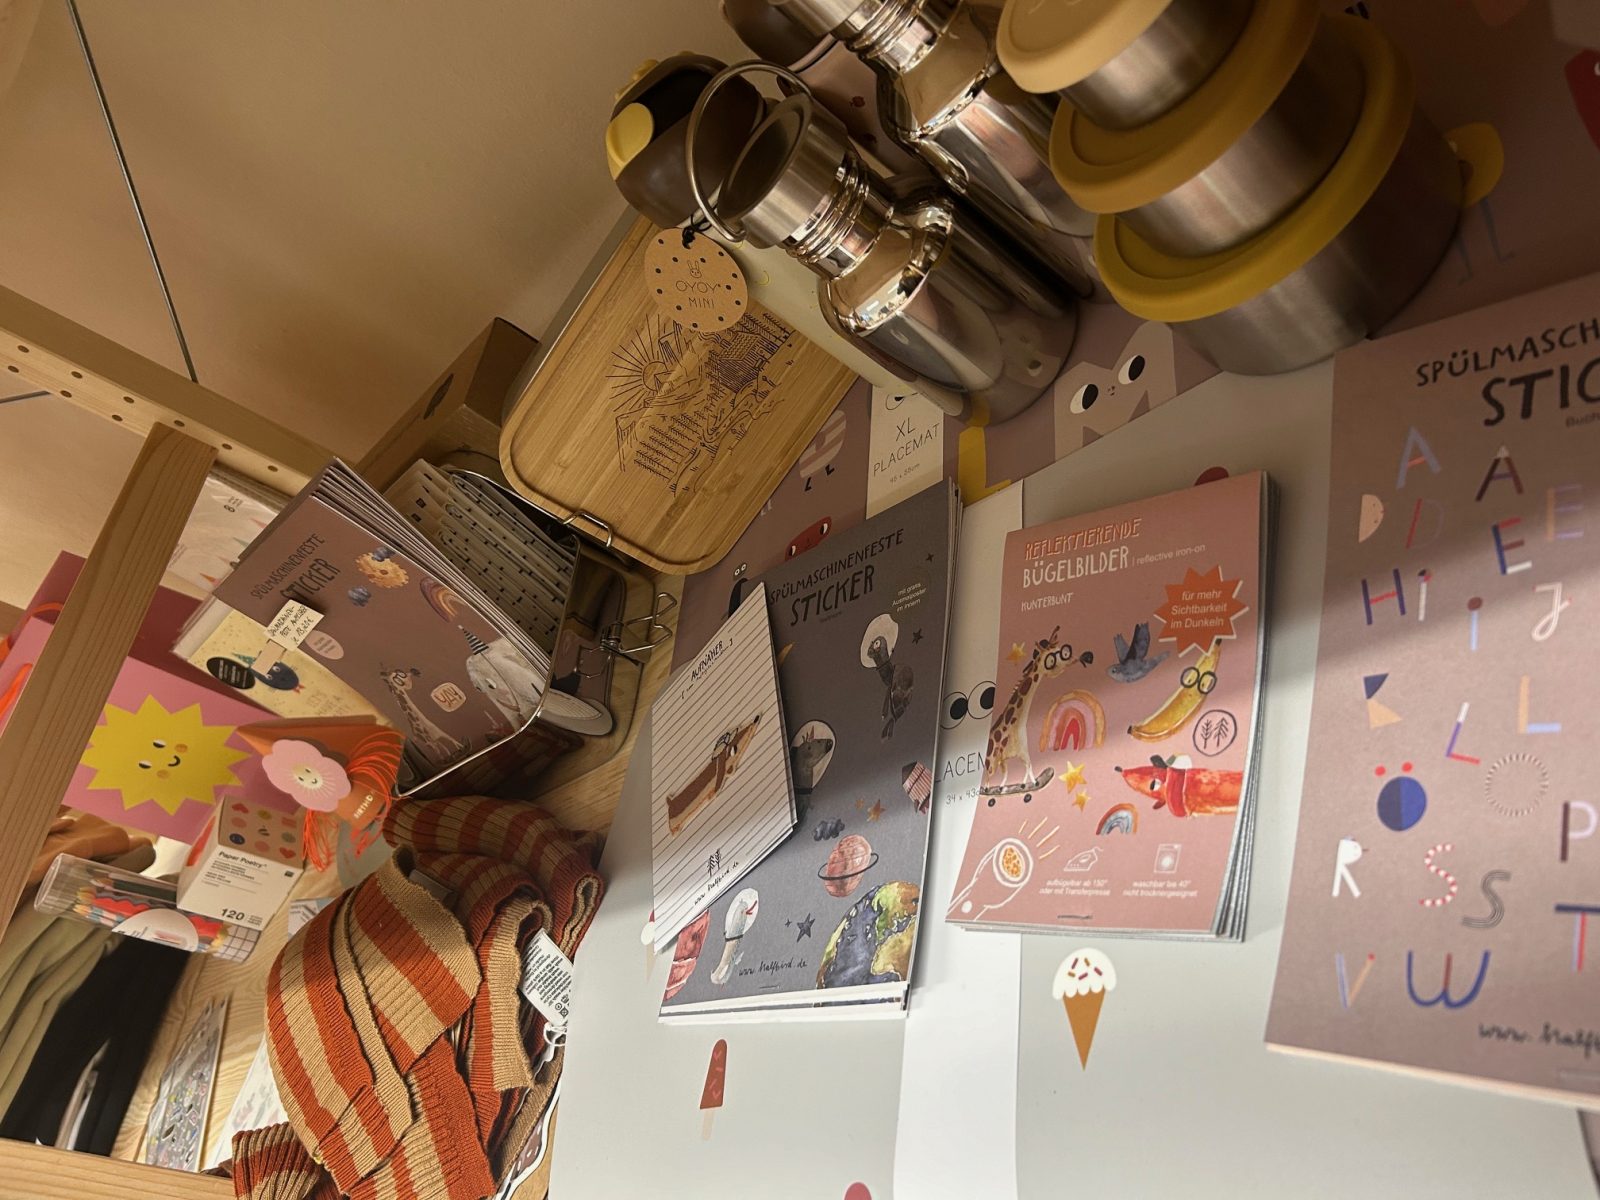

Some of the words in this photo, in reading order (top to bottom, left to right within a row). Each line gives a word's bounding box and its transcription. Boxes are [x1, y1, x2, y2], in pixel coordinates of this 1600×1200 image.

[688, 297, 715, 309] MINI
[1416, 317, 1600, 387] SPÜLMASCH
[873, 422, 940, 477] PLACEMAT
[896, 417, 916, 442] XL
[1396, 426, 1442, 489] A
[1475, 445, 1524, 502] A
[1024, 518, 1143, 561] REFLEKTIERENDE
[1492, 516, 1533, 576] E
[251, 533, 326, 600] SPÜLMASCHINENFESTE
[280, 558, 341, 600] STICKER
[770, 529, 904, 605] SPÜLMASCHINENFESTE
[1023, 545, 1129, 588] BÜGELBILDER
[1136, 549, 1174, 566] reflective
[1175, 543, 1206, 558] iron-on
[790, 565, 875, 626] STICKER
[1021, 592, 1073, 612] KUNTERBUNT
[1171, 602, 1228, 616] Sichtbarkeit
[1182, 590, 1194, 602] für
[1196, 589, 1222, 600] mehr
[1170, 618, 1182, 629] im
[1185, 617, 1225, 629] Dunkeln
[690, 640, 723, 681] AUFNÄHER
[1517, 675, 1562, 734] L
[218, 851, 240, 862] Paper
[1418, 843, 1459, 906] S
[1462, 869, 1512, 929] S
[221, 908, 245, 921] 120
